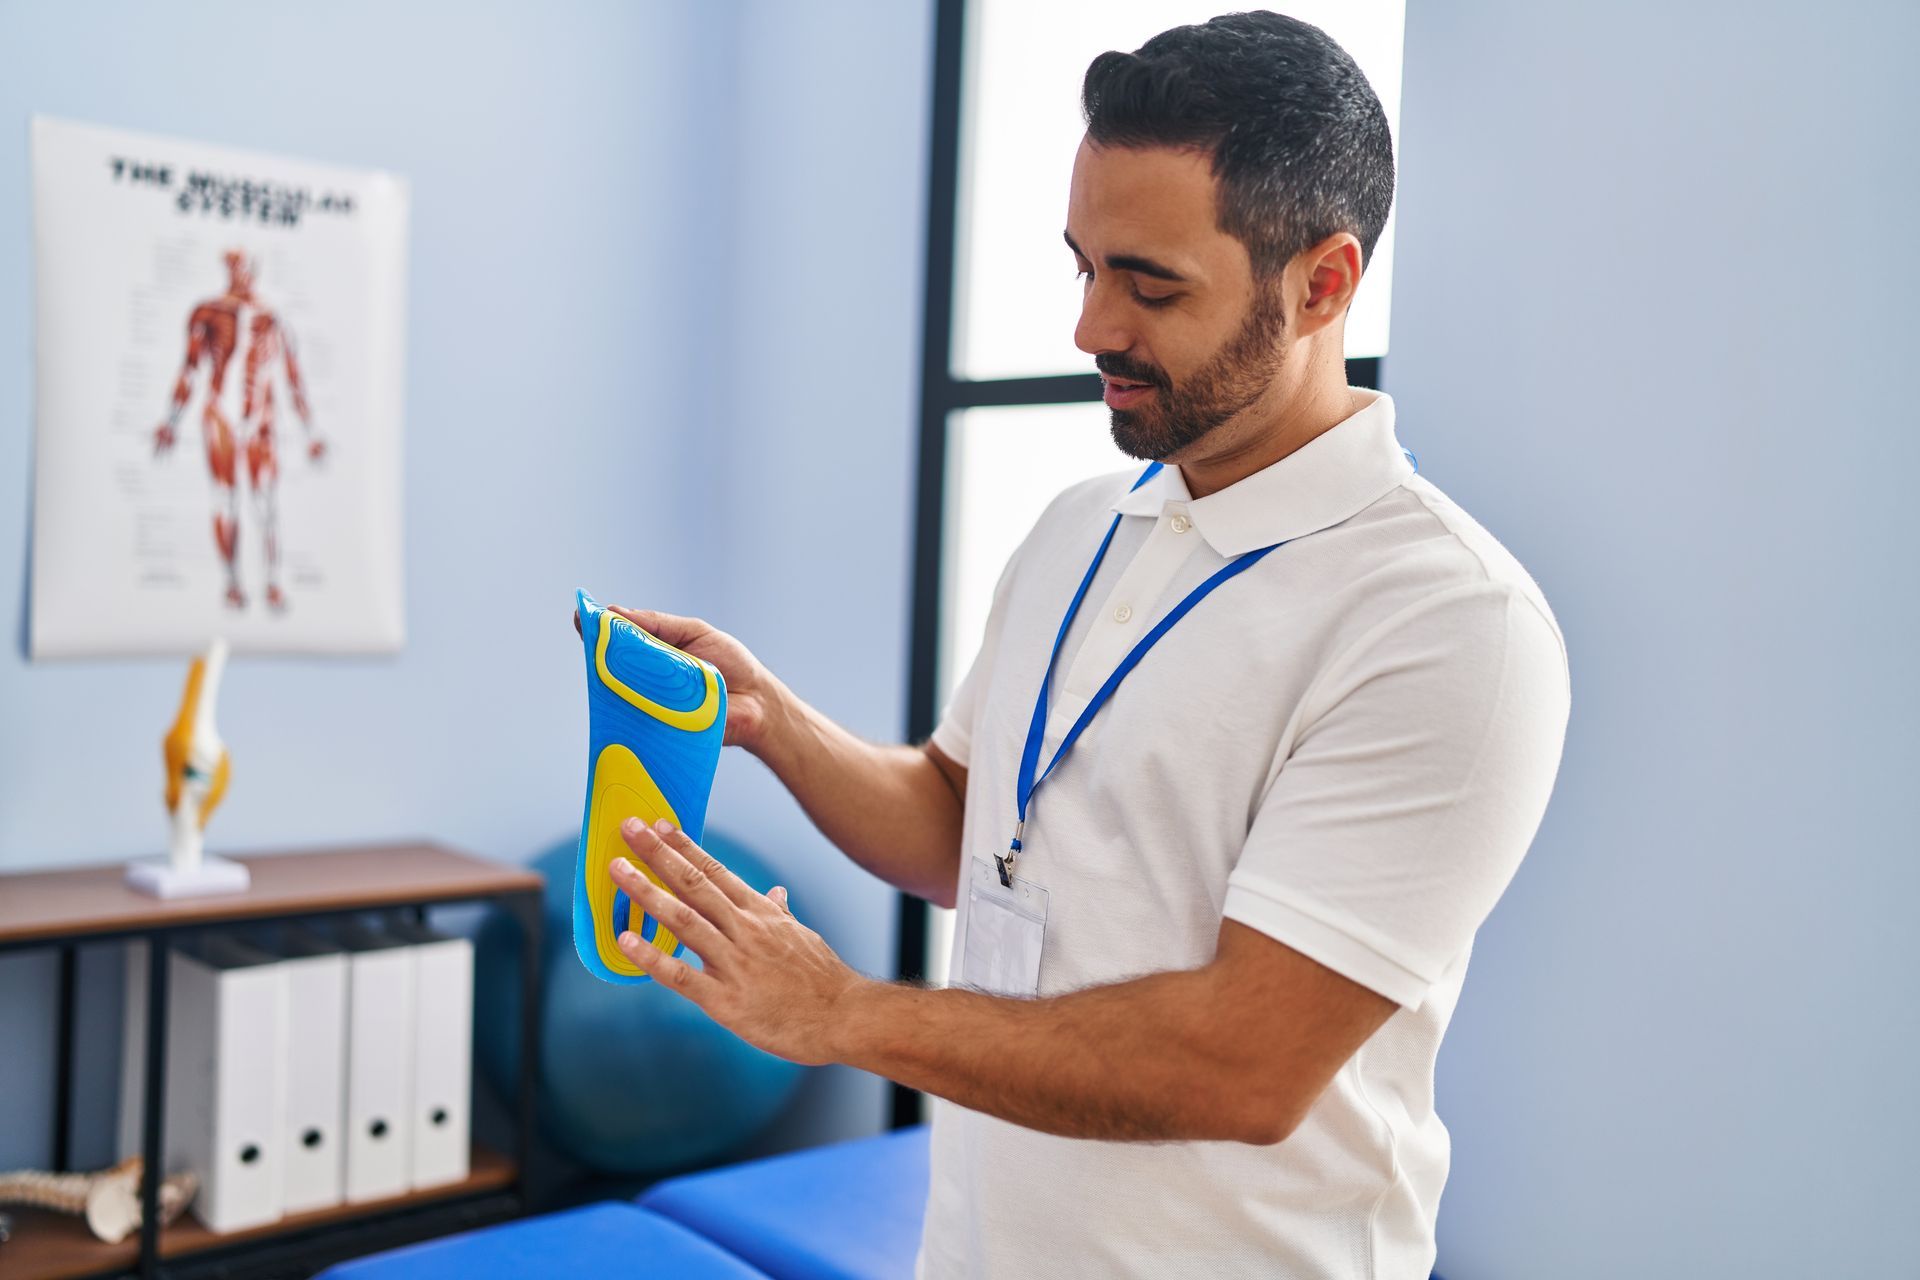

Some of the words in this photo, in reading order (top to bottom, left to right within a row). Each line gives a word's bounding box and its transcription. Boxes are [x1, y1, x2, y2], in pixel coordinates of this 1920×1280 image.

[110, 156, 172, 186] THE
[187, 169, 355, 214] MUSCULAR
[175, 192, 302, 227] SYSTEM
